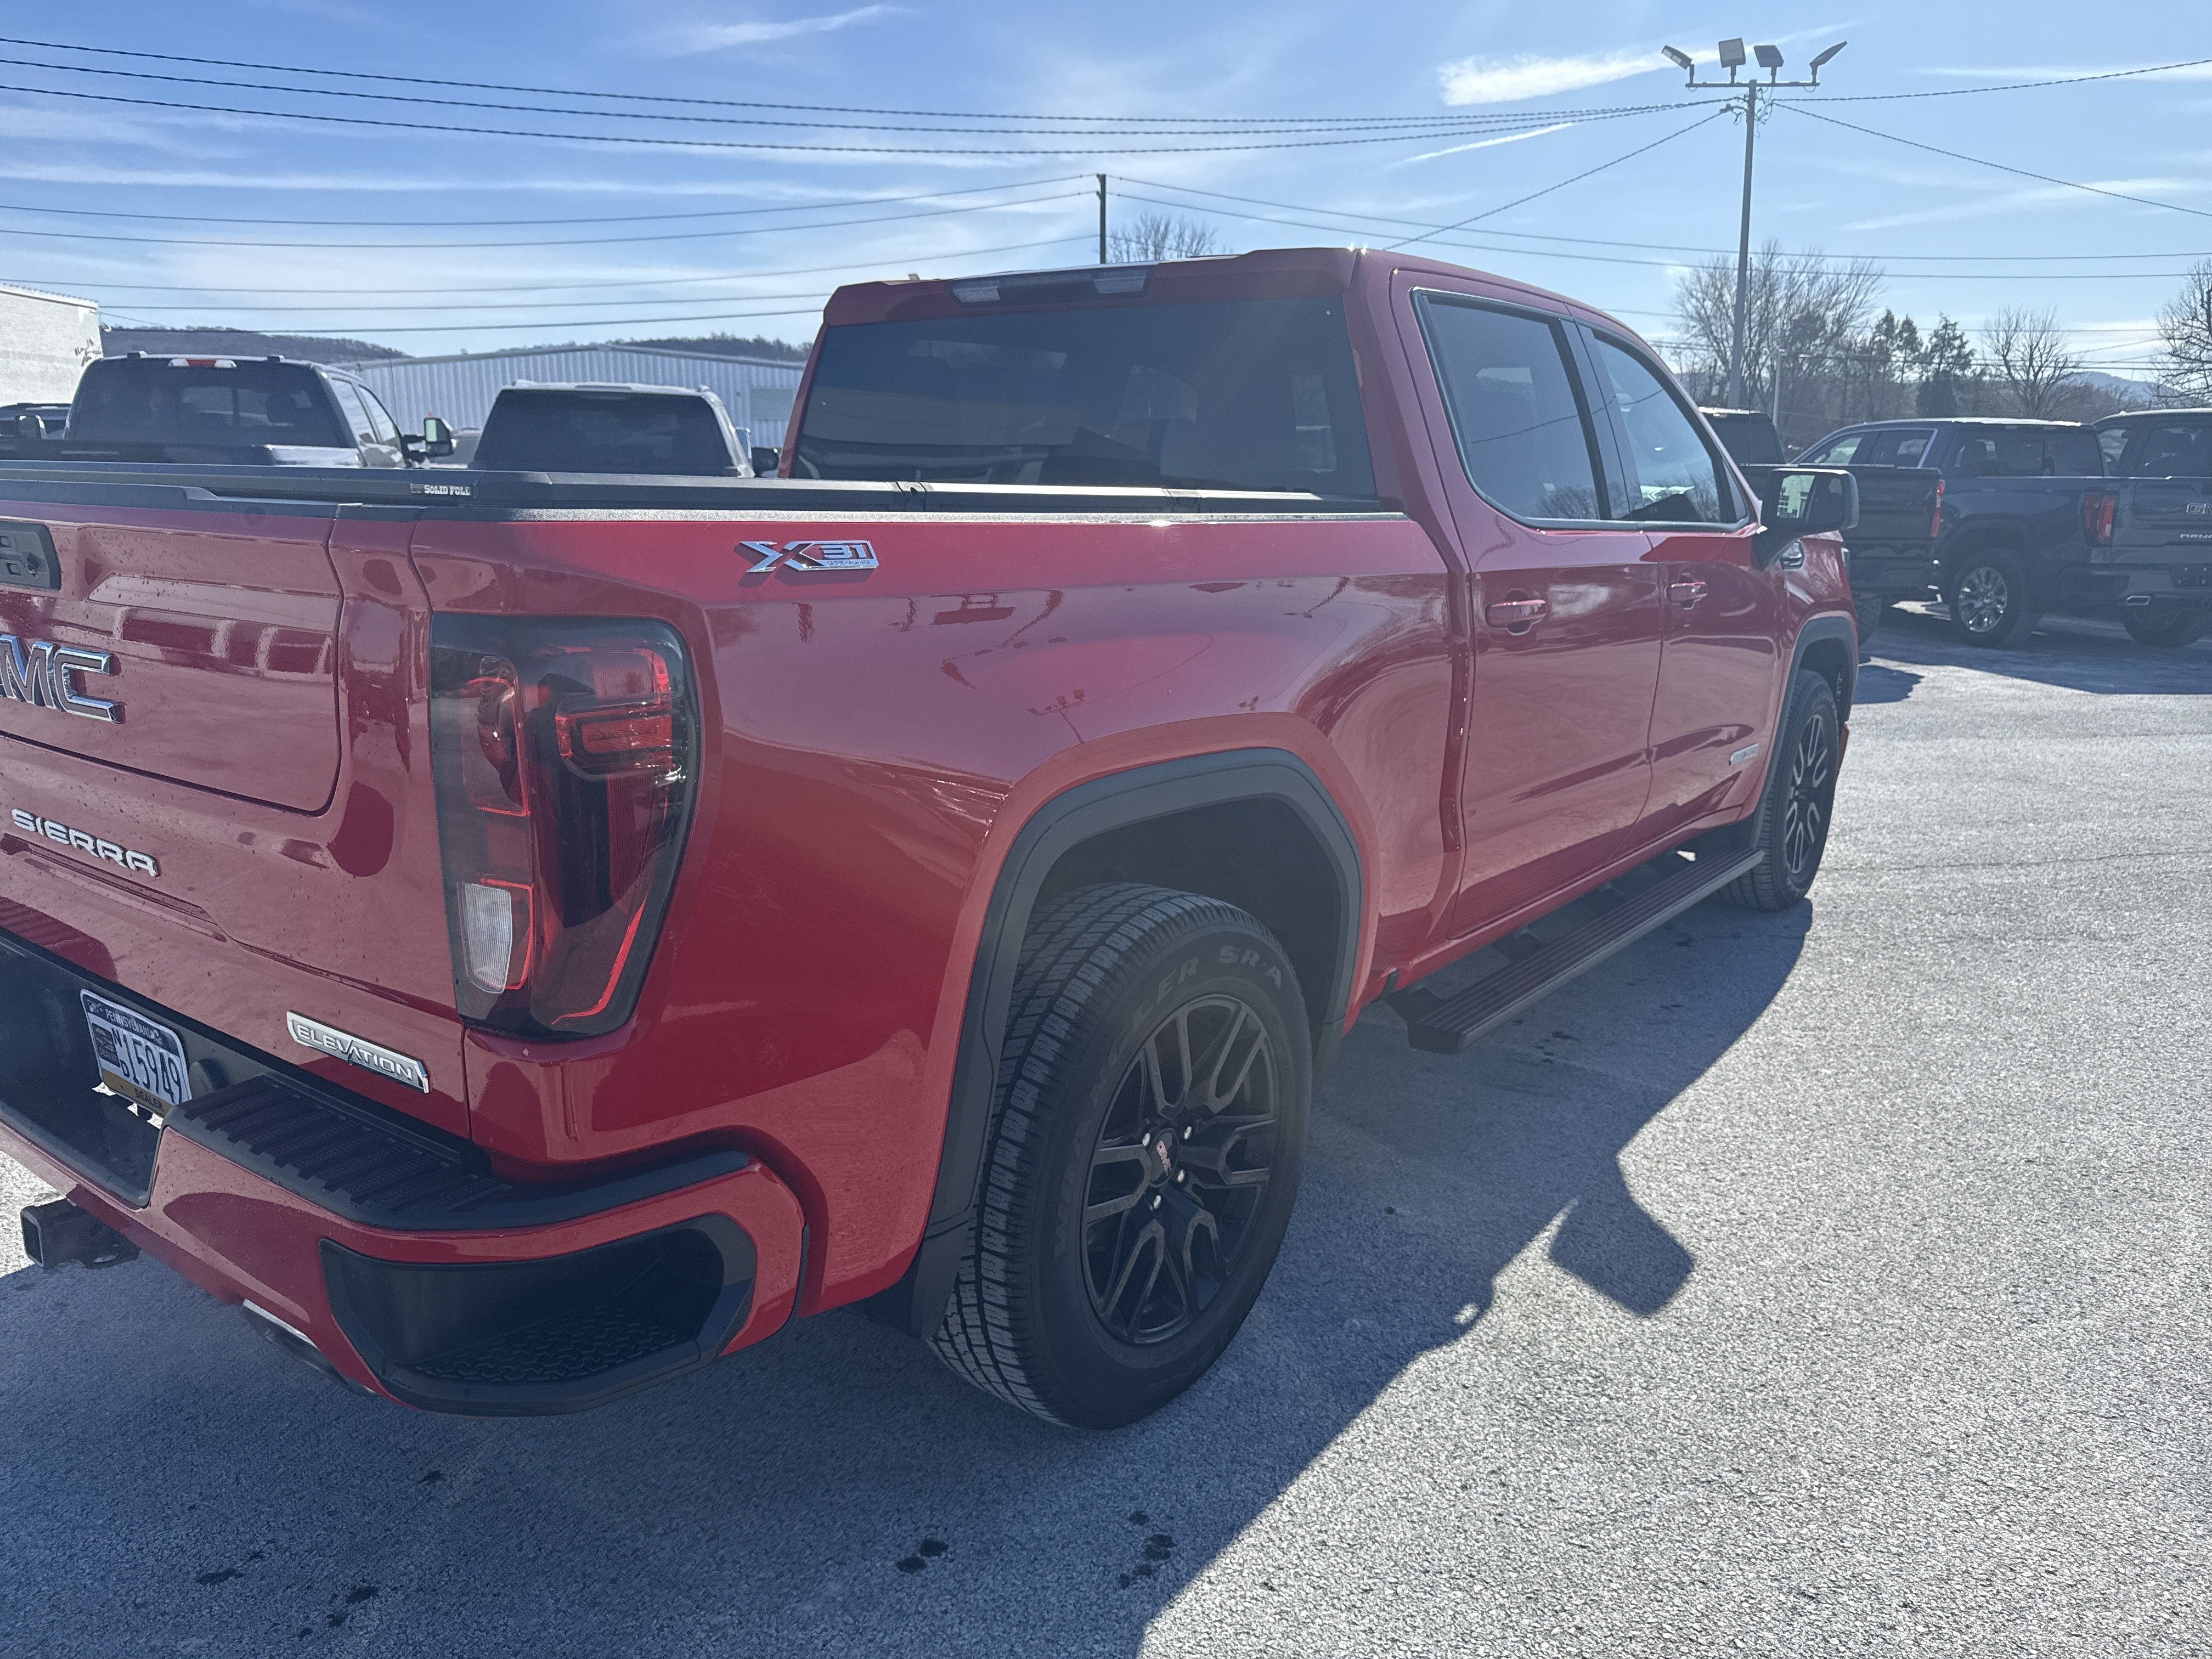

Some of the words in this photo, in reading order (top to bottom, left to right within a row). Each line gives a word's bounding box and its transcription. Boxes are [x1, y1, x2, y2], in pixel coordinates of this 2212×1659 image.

[424, 484, 448, 495] SOLID
[740, 540, 879, 572] X31
[0, 635, 125, 724] MC
[12, 808, 160, 877] SIERRA
[297, 1024, 412, 1080] ELEVATION
[134, 1088, 164, 1111] DEALER
